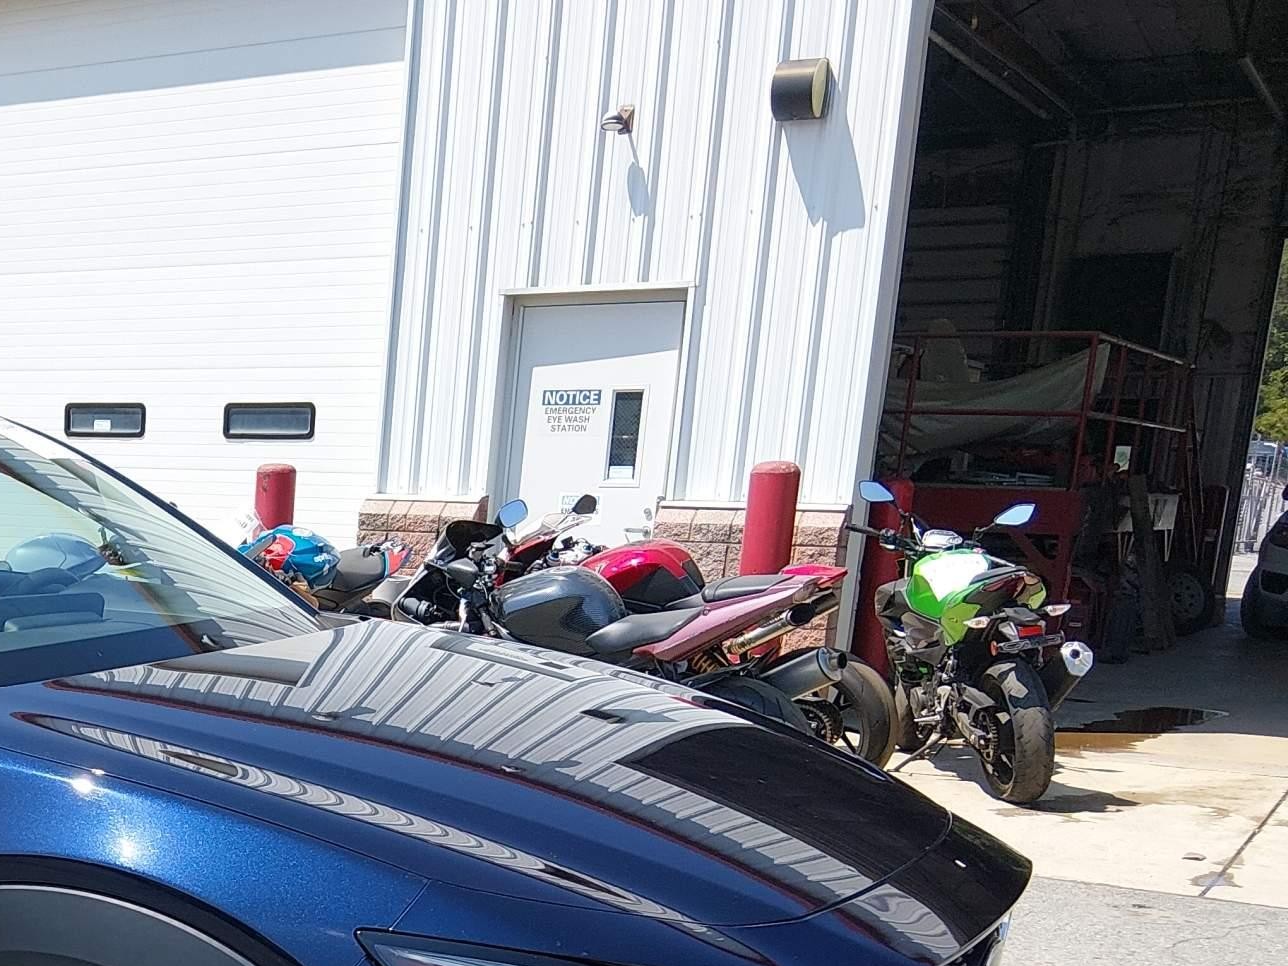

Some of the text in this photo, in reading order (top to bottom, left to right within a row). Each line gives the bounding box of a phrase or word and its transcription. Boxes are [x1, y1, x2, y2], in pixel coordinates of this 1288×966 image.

[544, 390, 599, 405] NOTICE
[544, 406, 597, 415] EMERGENCY
[547, 415, 590, 424] EYE WASH
[550, 424, 587, 433] STATION
